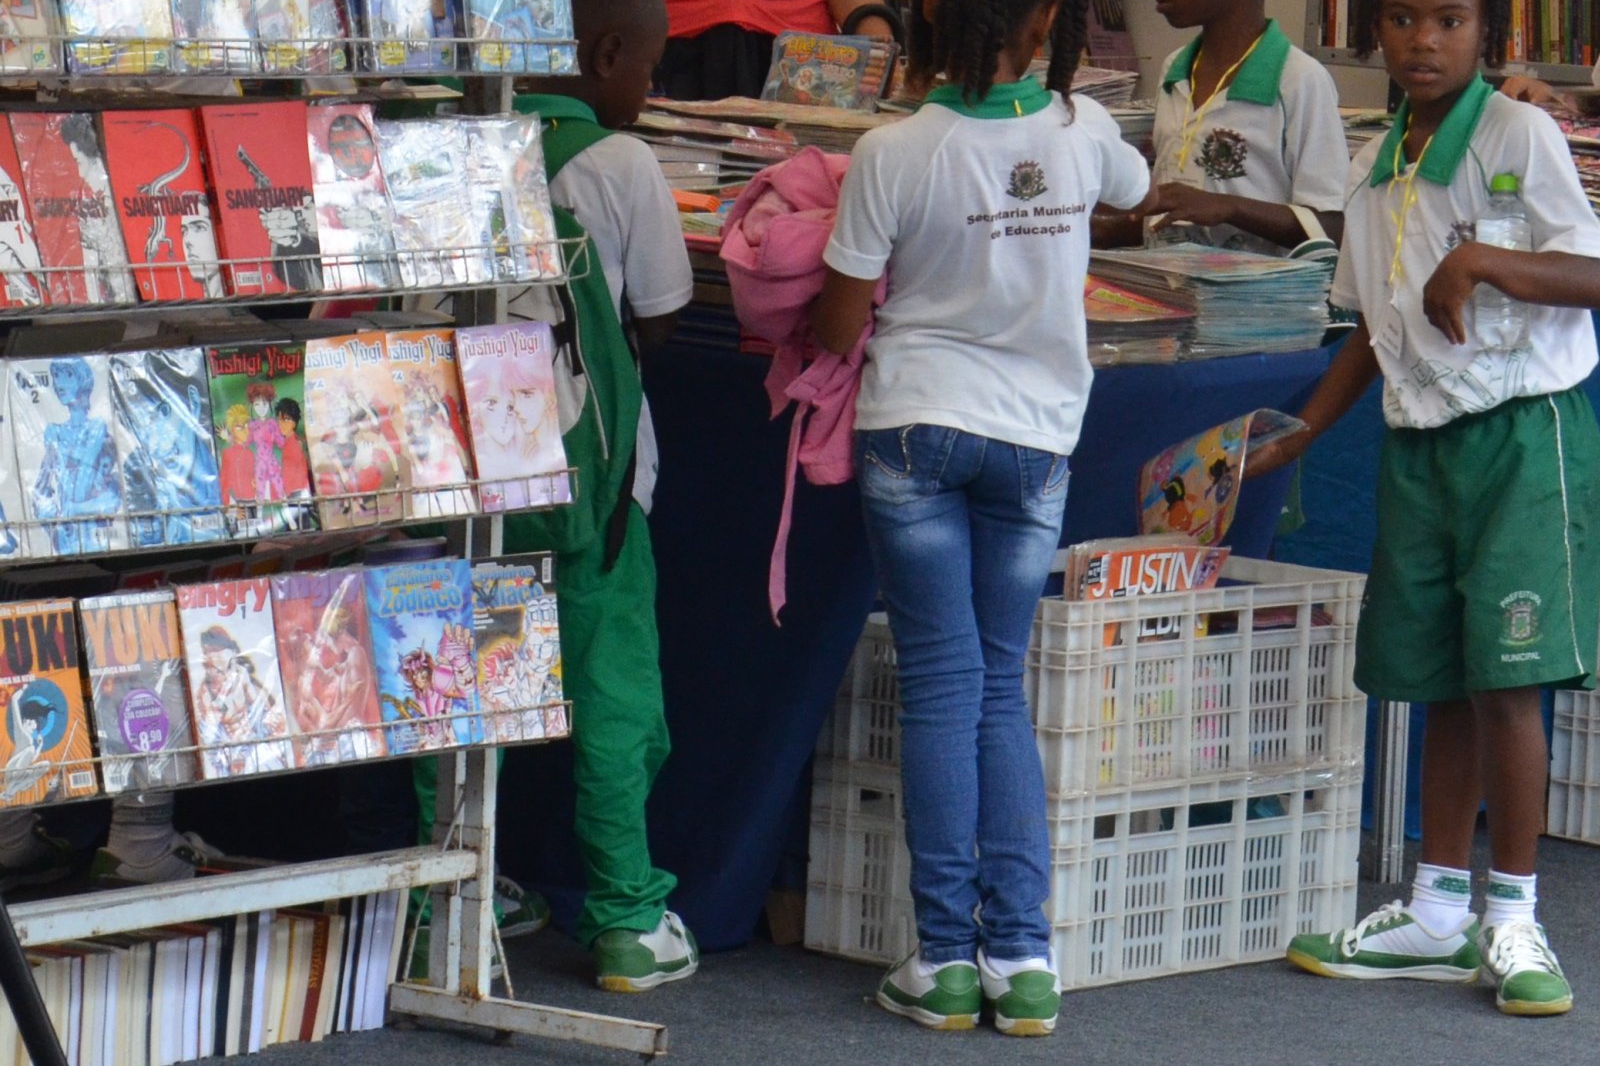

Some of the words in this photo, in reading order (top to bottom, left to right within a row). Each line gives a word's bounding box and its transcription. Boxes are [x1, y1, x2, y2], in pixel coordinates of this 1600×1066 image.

[122, 194, 201, 218] SANCTUARY
[225, 185, 305, 211] SANCTUARY
[1005, 223, 1071, 237] Educação
[31, 391, 40, 404] 2
[82, 600, 181, 666] YUKI
[1501, 651, 1541, 663] MUNICIPAL
